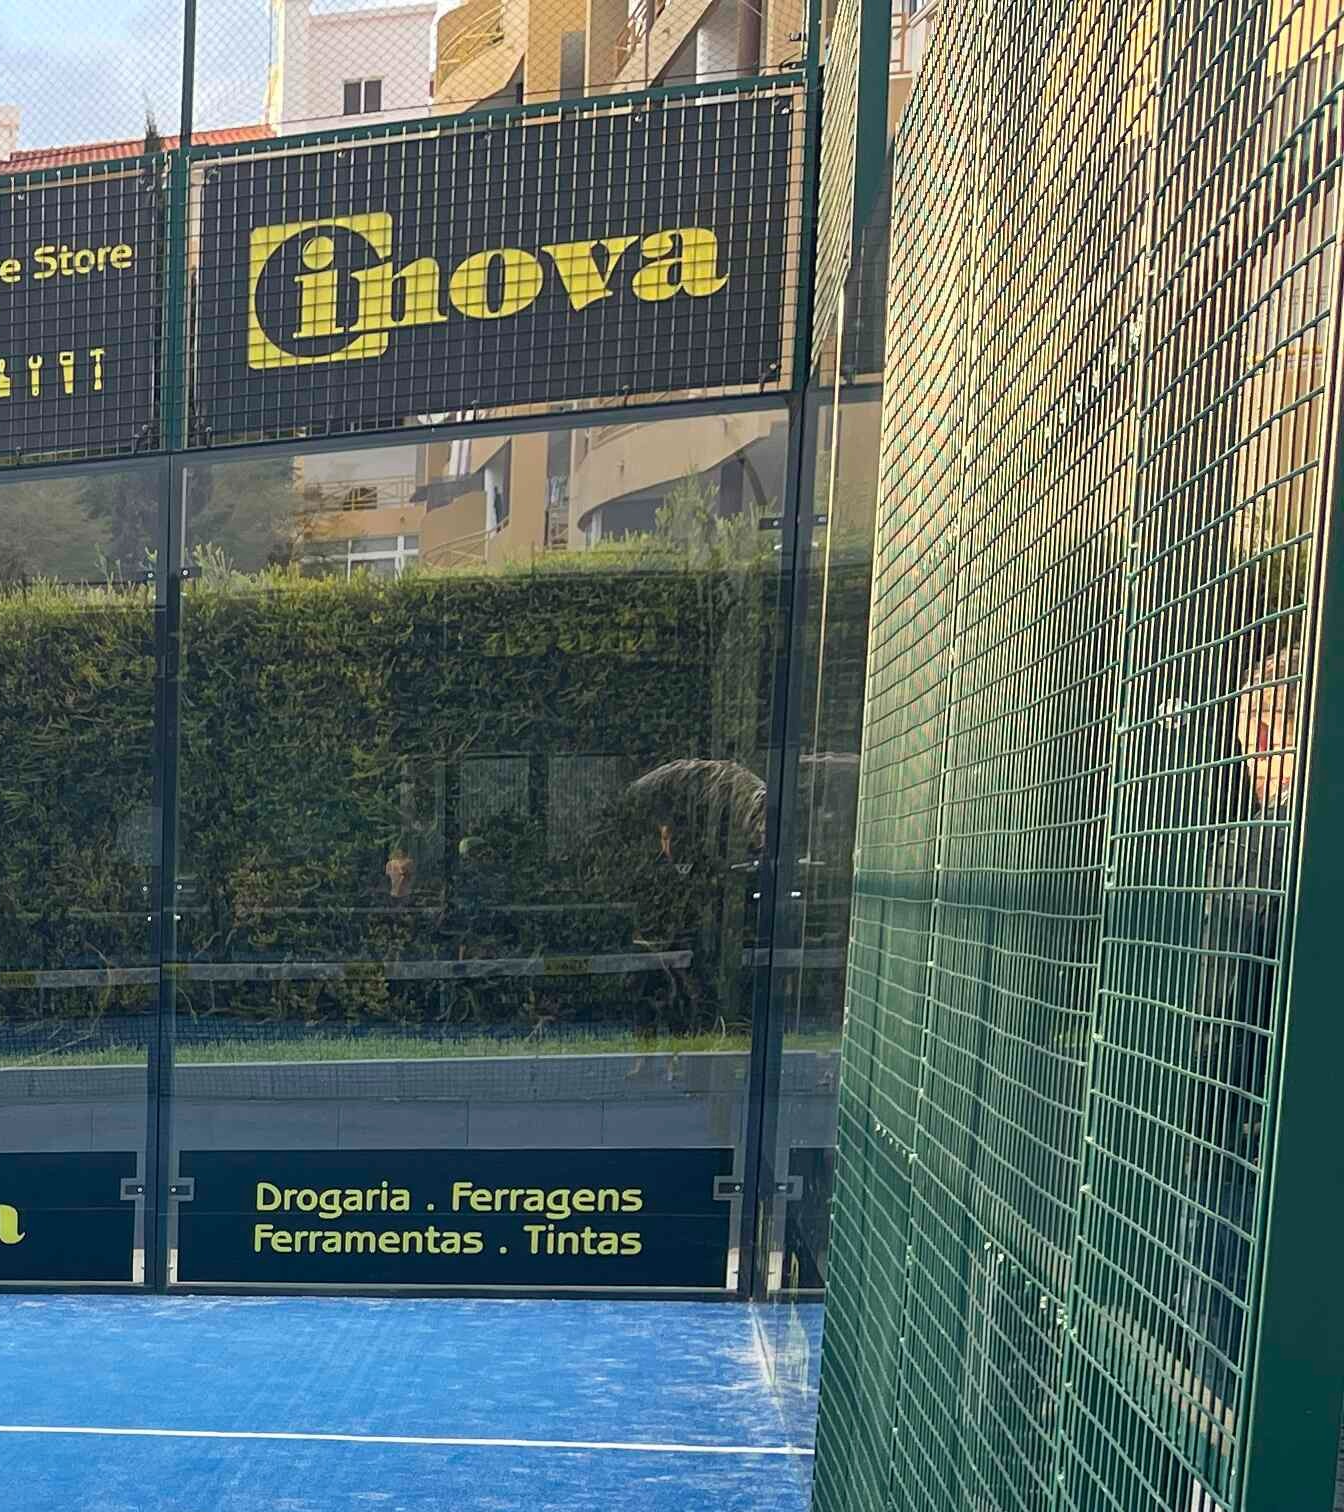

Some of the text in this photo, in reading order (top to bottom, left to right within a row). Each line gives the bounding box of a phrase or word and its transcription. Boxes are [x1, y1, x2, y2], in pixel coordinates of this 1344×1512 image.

[33, 242, 133, 280] Store
[255, 1181, 411, 1220] Drogaria
[452, 1182, 643, 1221] Ferragens
[253, 1223, 484, 1255] Ferramentas
[523, 1223, 643, 1255] Tintas
